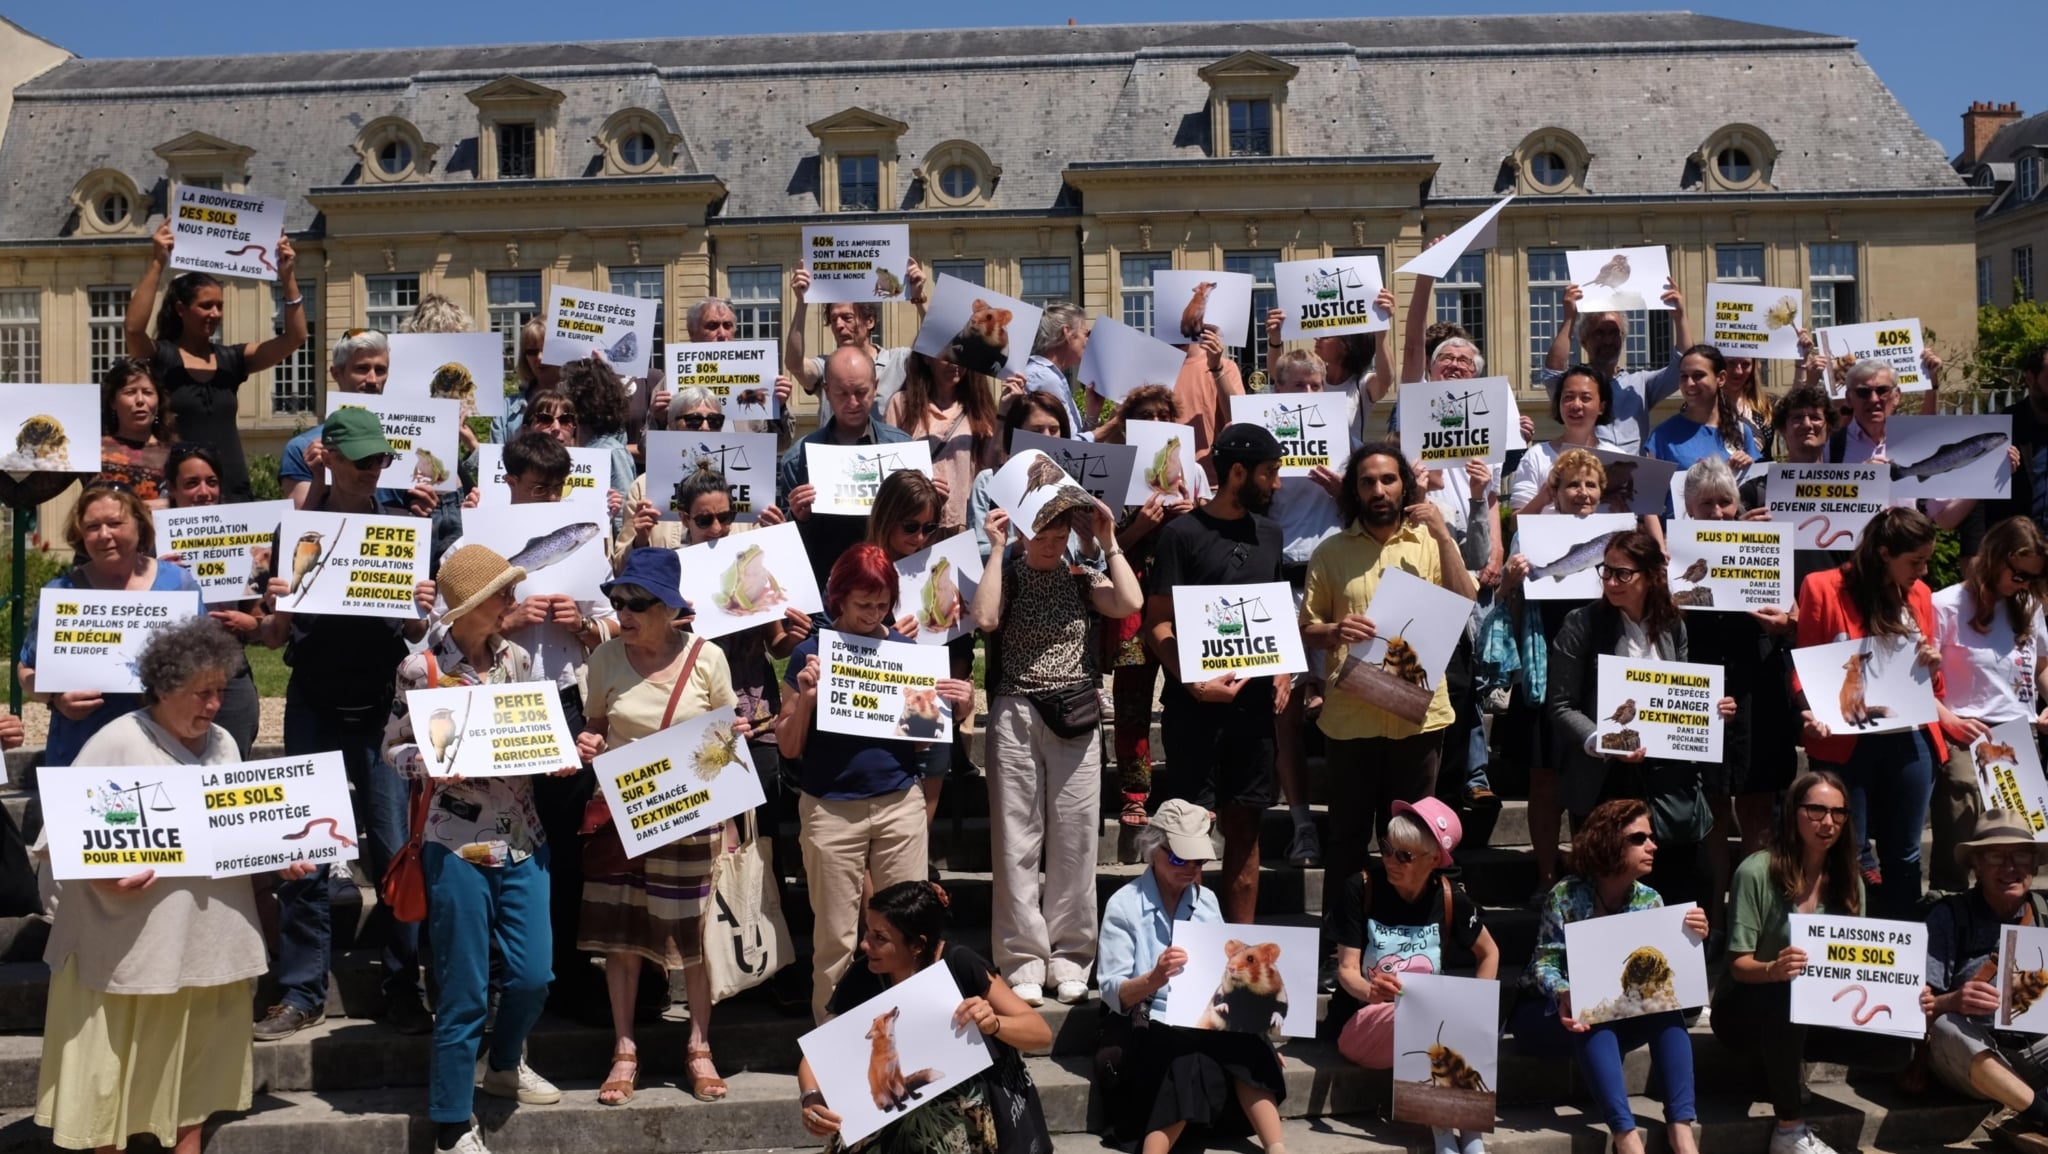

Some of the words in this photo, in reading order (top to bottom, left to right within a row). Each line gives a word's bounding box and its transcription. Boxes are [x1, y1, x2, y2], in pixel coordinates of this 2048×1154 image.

[182, 192, 195, 201] LA
[199, 195, 264, 213] BIODIVERSITÉ
[180, 207, 202, 220] DES
[208, 211, 236, 225] SOLS
[177, 223, 203, 234] NOUS
[207, 227, 251, 241] PROTÈGE
[813, 237, 833, 247] 40%
[839, 248, 879, 257] MENACÉS
[241, 265, 262, 274] AUSSI
[813, 262, 872, 270] D'EXTINCTION
[561, 298, 575, 307] 31%
[578, 301, 595, 310] DES
[598, 304, 636, 317] ESPÈCES
[1301, 300, 1366, 319] JUSTICE
[1722, 303, 1753, 311] PLANTE
[558, 319, 570, 328] EN
[573, 320, 604, 333] DÉCLIN
[1301, 321, 1324, 329] POUR
[1338, 316, 1366, 325] VIVANT
[568, 332, 594, 341] EUROPE
[1715, 332, 1769, 341] D'EXTINCTION
[1879, 330, 1910, 346] 40%
[677, 350, 765, 361] EFFONDREMENT
[1874, 347, 1913, 356] INSECTES
[678, 364, 692, 373] DE
[696, 364, 718, 373] 80%
[678, 376, 695, 384] DES
[699, 375, 760, 384] POPULATIONS
[388, 414, 435, 423] AMPHIBIENS
[1422, 428, 1489, 449] JUSTICE
[1422, 450, 1444, 459] POUR
[1448, 449, 1457, 457] LE
[1460, 447, 1489, 456] VIVANT
[1781, 470, 1795, 479] NE
[1799, 470, 1850, 480] LAISSONS
[1854, 471, 1876, 480] PAS
[1796, 485, 1820, 497] NOS
[1826, 486, 1858, 497] SOLS
[1771, 502, 1815, 511] DEVENIR
[1821, 503, 1881, 512] SILENCIEUX
[170, 529, 183, 537] LA
[187, 524, 248, 535] POPULATION
[366, 527, 415, 542] PERTE
[171, 537, 224, 549] D'ANIMAUX
[229, 533, 275, 545] SAUVAGE
[1696, 532, 1721, 541] PLUS
[1742, 534, 1780, 544] MILLION
[204, 548, 244, 559] RÉDUITE
[360, 543, 380, 556] DE
[385, 545, 413, 558] 30%
[1740, 545, 1780, 554] D'ESPÈCES
[332, 558, 349, 566] DES
[353, 560, 413, 570] POPULATIONS
[1722, 556, 1735, 564] EN
[1740, 557, 1779, 566] DANGER
[198, 563, 224, 575] 60%
[1711, 568, 1780, 579] D'EXTINCTION
[351, 571, 412, 585] D'OISEAUX
[346, 587, 411, 601] AGRICOLES
[56, 604, 78, 614] 31%
[83, 605, 107, 615] DES
[112, 603, 167, 616] ESPÈCES
[72, 619, 124, 628] PAPILLONS
[55, 632, 71, 642] EN
[77, 629, 121, 643] DÉCLIN
[54, 646, 67, 654] EN
[71, 647, 108, 655] EUROPE
[832, 641, 858, 653] DEPUIS
[1202, 636, 1278, 658] JUSTICE
[832, 653, 843, 663] LA
[847, 655, 903, 671] POPULATION
[1203, 660, 1228, 669] POUR
[1231, 658, 1242, 667] LE
[1244, 655, 1279, 666] VIVANT
[831, 665, 880, 680] D'ANIMAUX
[884, 674, 934, 686] SAUVAGES
[1626, 670, 1651, 681] PLUS
[1671, 677, 1710, 688] MILLION
[831, 678, 855, 690] S'EST
[859, 680, 898, 694] RÉDUITE
[1668, 688, 1710, 698] D'ESPÈCES
[494, 693, 544, 708] PERTE
[831, 691, 847, 704] DE
[852, 694, 878, 709] 60%
[1650, 698, 1663, 707] EN
[1667, 699, 1709, 711] DANGER
[494, 711, 514, 724] DE
[519, 711, 547, 721] 30%
[831, 707, 852, 717] DANS
[855, 710, 864, 719] LE
[867, 713, 895, 722] MONDE
[1639, 710, 1709, 725] D'EXTINCTION
[469, 729, 487, 737] DES
[490, 724, 551, 735] POPULATIONS
[492, 734, 556, 748] D'OISEAUX
[1667, 735, 1708, 744] PROCHAINES
[494, 747, 560, 762] AGRICOLES
[1672, 743, 1708, 752] DÉCENNIES
[202, 774, 219, 786] LA
[224, 760, 315, 784] BIODIVERSITÉ
[615, 777, 621, 789] 1
[624, 759, 671, 786] PLANTE
[205, 792, 236, 809] DES
[244, 787, 284, 804] SOLS
[622, 786, 644, 803] SUR
[649, 782, 656, 793] 5
[626, 802, 643, 814] EST
[646, 784, 688, 807] MENACÉE
[209, 813, 244, 828] NOUS
[250, 804, 311, 823] PROTÈGE
[630, 790, 710, 829] D'EXTINCTION
[636, 827, 659, 841] DANS
[660, 822, 671, 831] LE
[673, 810, 700, 826] MONDE
[83, 828, 181, 850] JUSTICE
[84, 853, 118, 863] POUR
[123, 852, 136, 862] LE
[139, 851, 183, 862] VIVANT
[308, 847, 337, 860] AUSSI
[1417, 926, 1438, 938] QUE
[1808, 926, 1825, 937] NE
[1830, 927, 1884, 943] LAISSONS
[1889, 933, 1911, 945] PAS
[1373, 938, 1385, 950] LE
[1400, 940, 1427, 952] TOFU
[1828, 946, 1856, 961] NOS
[1862, 949, 1894, 964] SOLS
[1800, 966, 1851, 979] DEVENIR
[1856, 970, 1919, 986] SILENCIEUX
